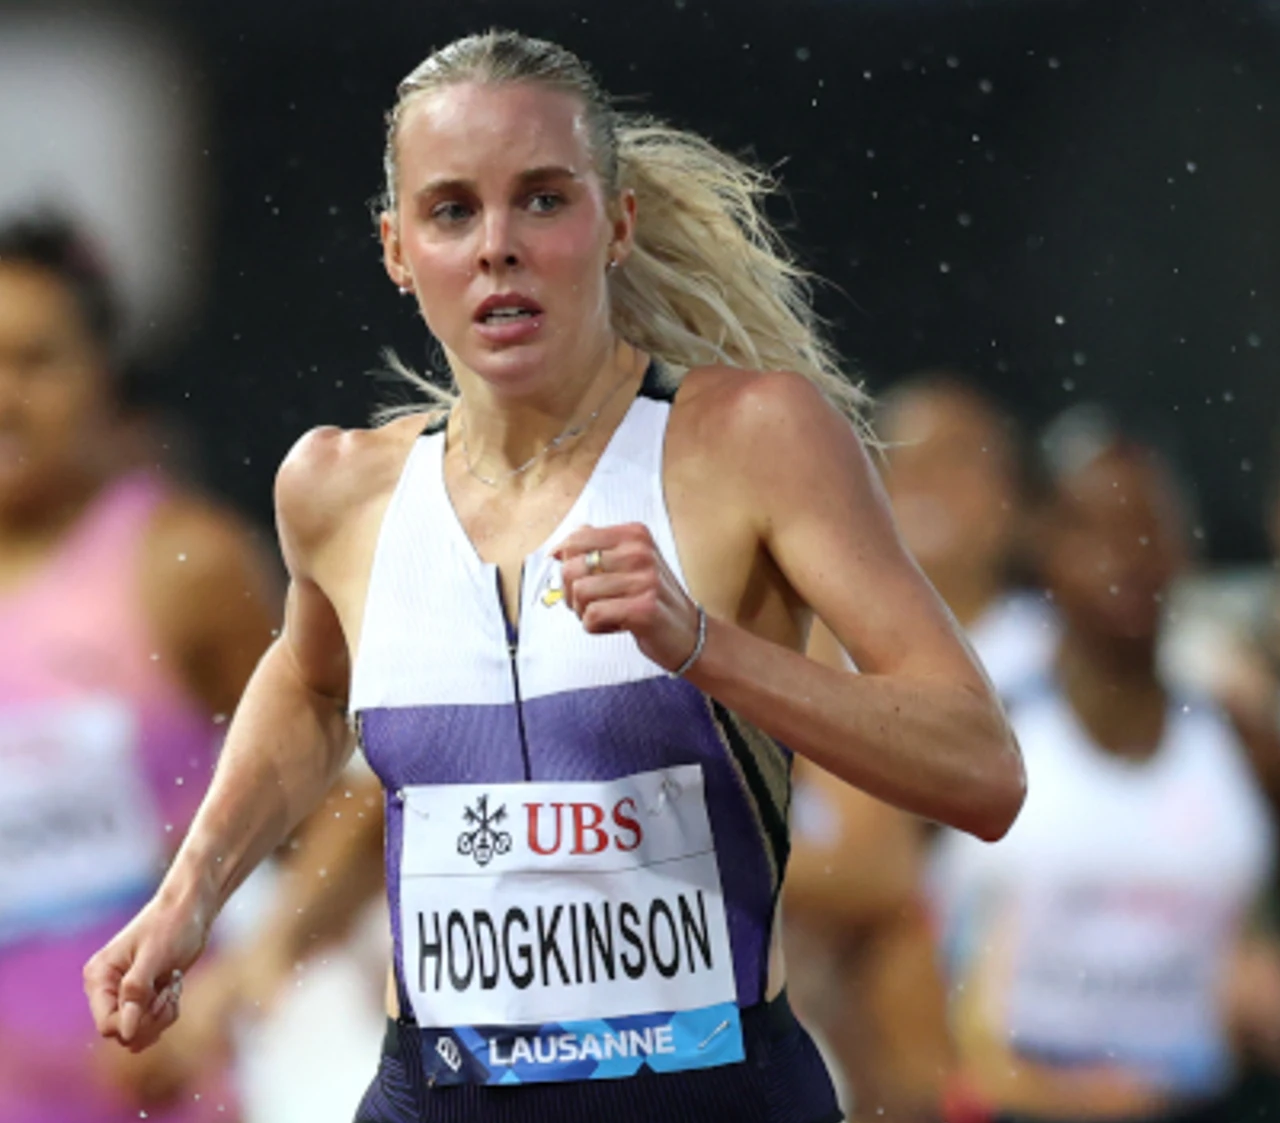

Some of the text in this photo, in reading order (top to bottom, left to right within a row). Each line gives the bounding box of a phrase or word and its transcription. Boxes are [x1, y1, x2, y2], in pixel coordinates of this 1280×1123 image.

[523, 797, 644, 856] UBS
[417, 890, 713, 993] HODGKINSON
[488, 1024, 677, 1066] LAUSANNE
